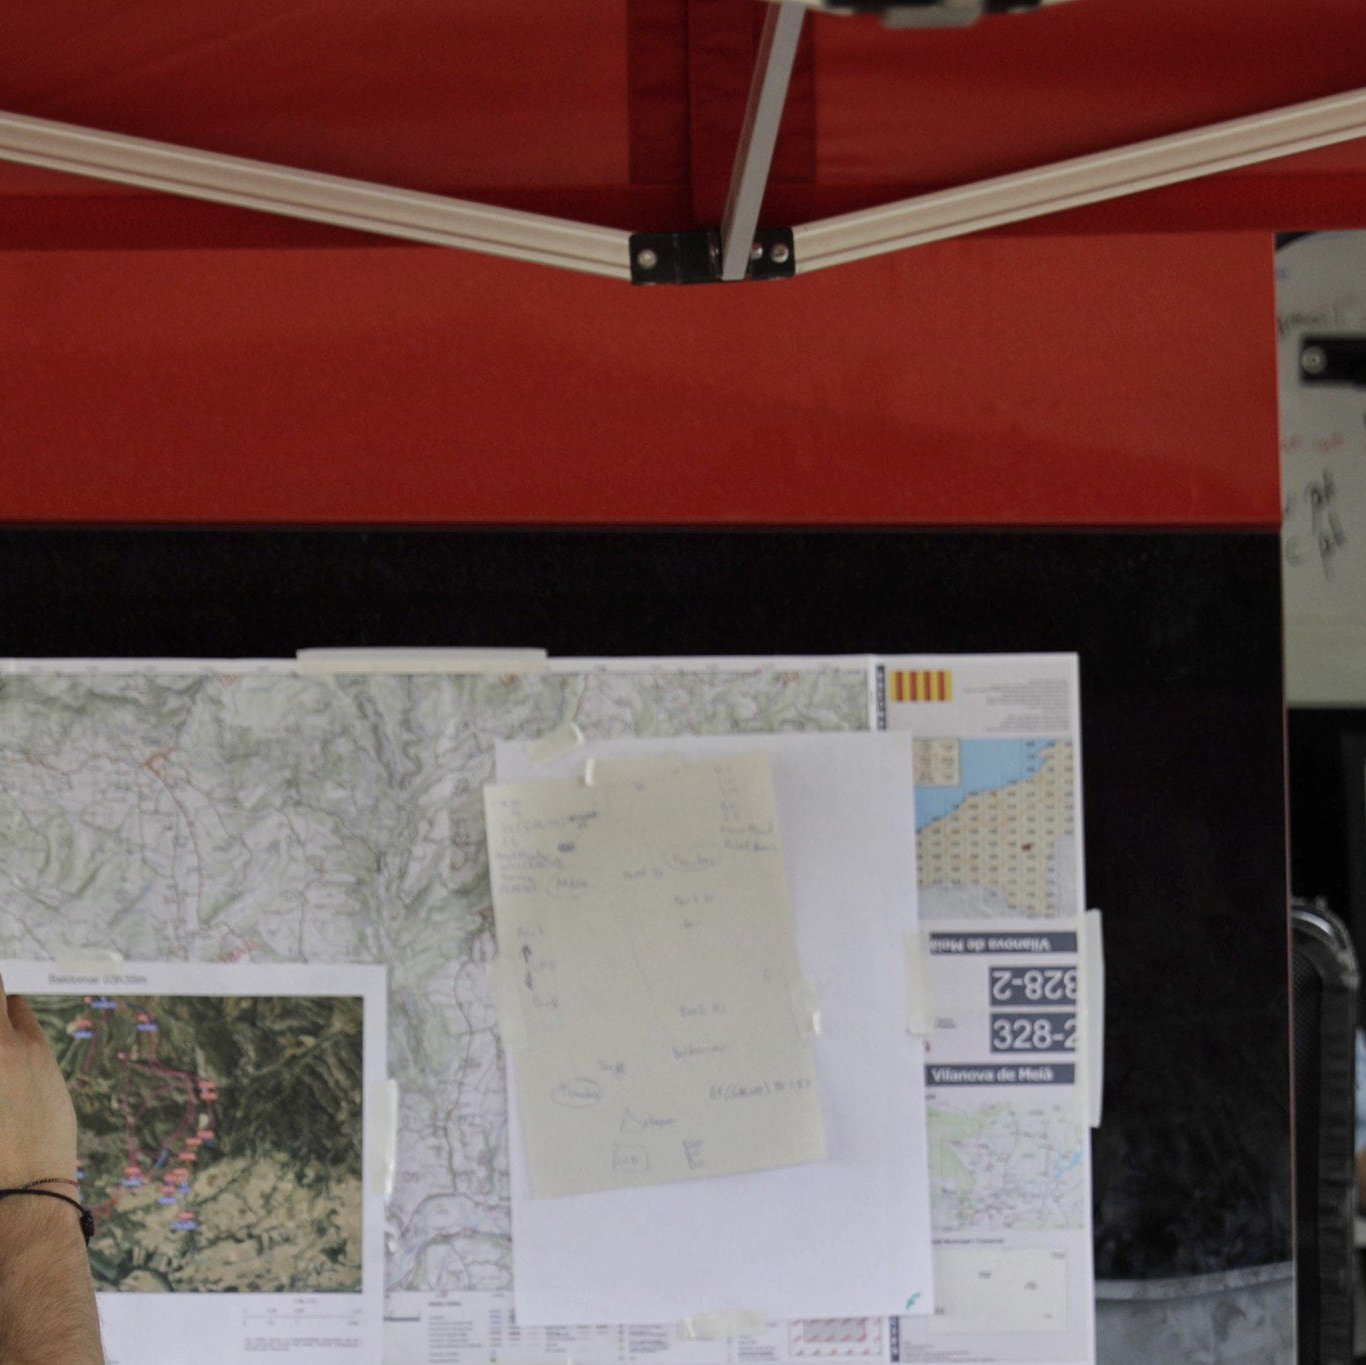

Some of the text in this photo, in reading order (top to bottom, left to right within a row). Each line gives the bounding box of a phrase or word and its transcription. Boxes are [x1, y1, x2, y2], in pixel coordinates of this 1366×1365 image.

[967, 939, 984, 951] de
[988, 938, 1051, 951] Vilanova
[993, 969, 1077, 1000] 328-2
[993, 1018, 1076, 1049] 328-2
[931, 1067, 1054, 1082] Vilanova de Meià
